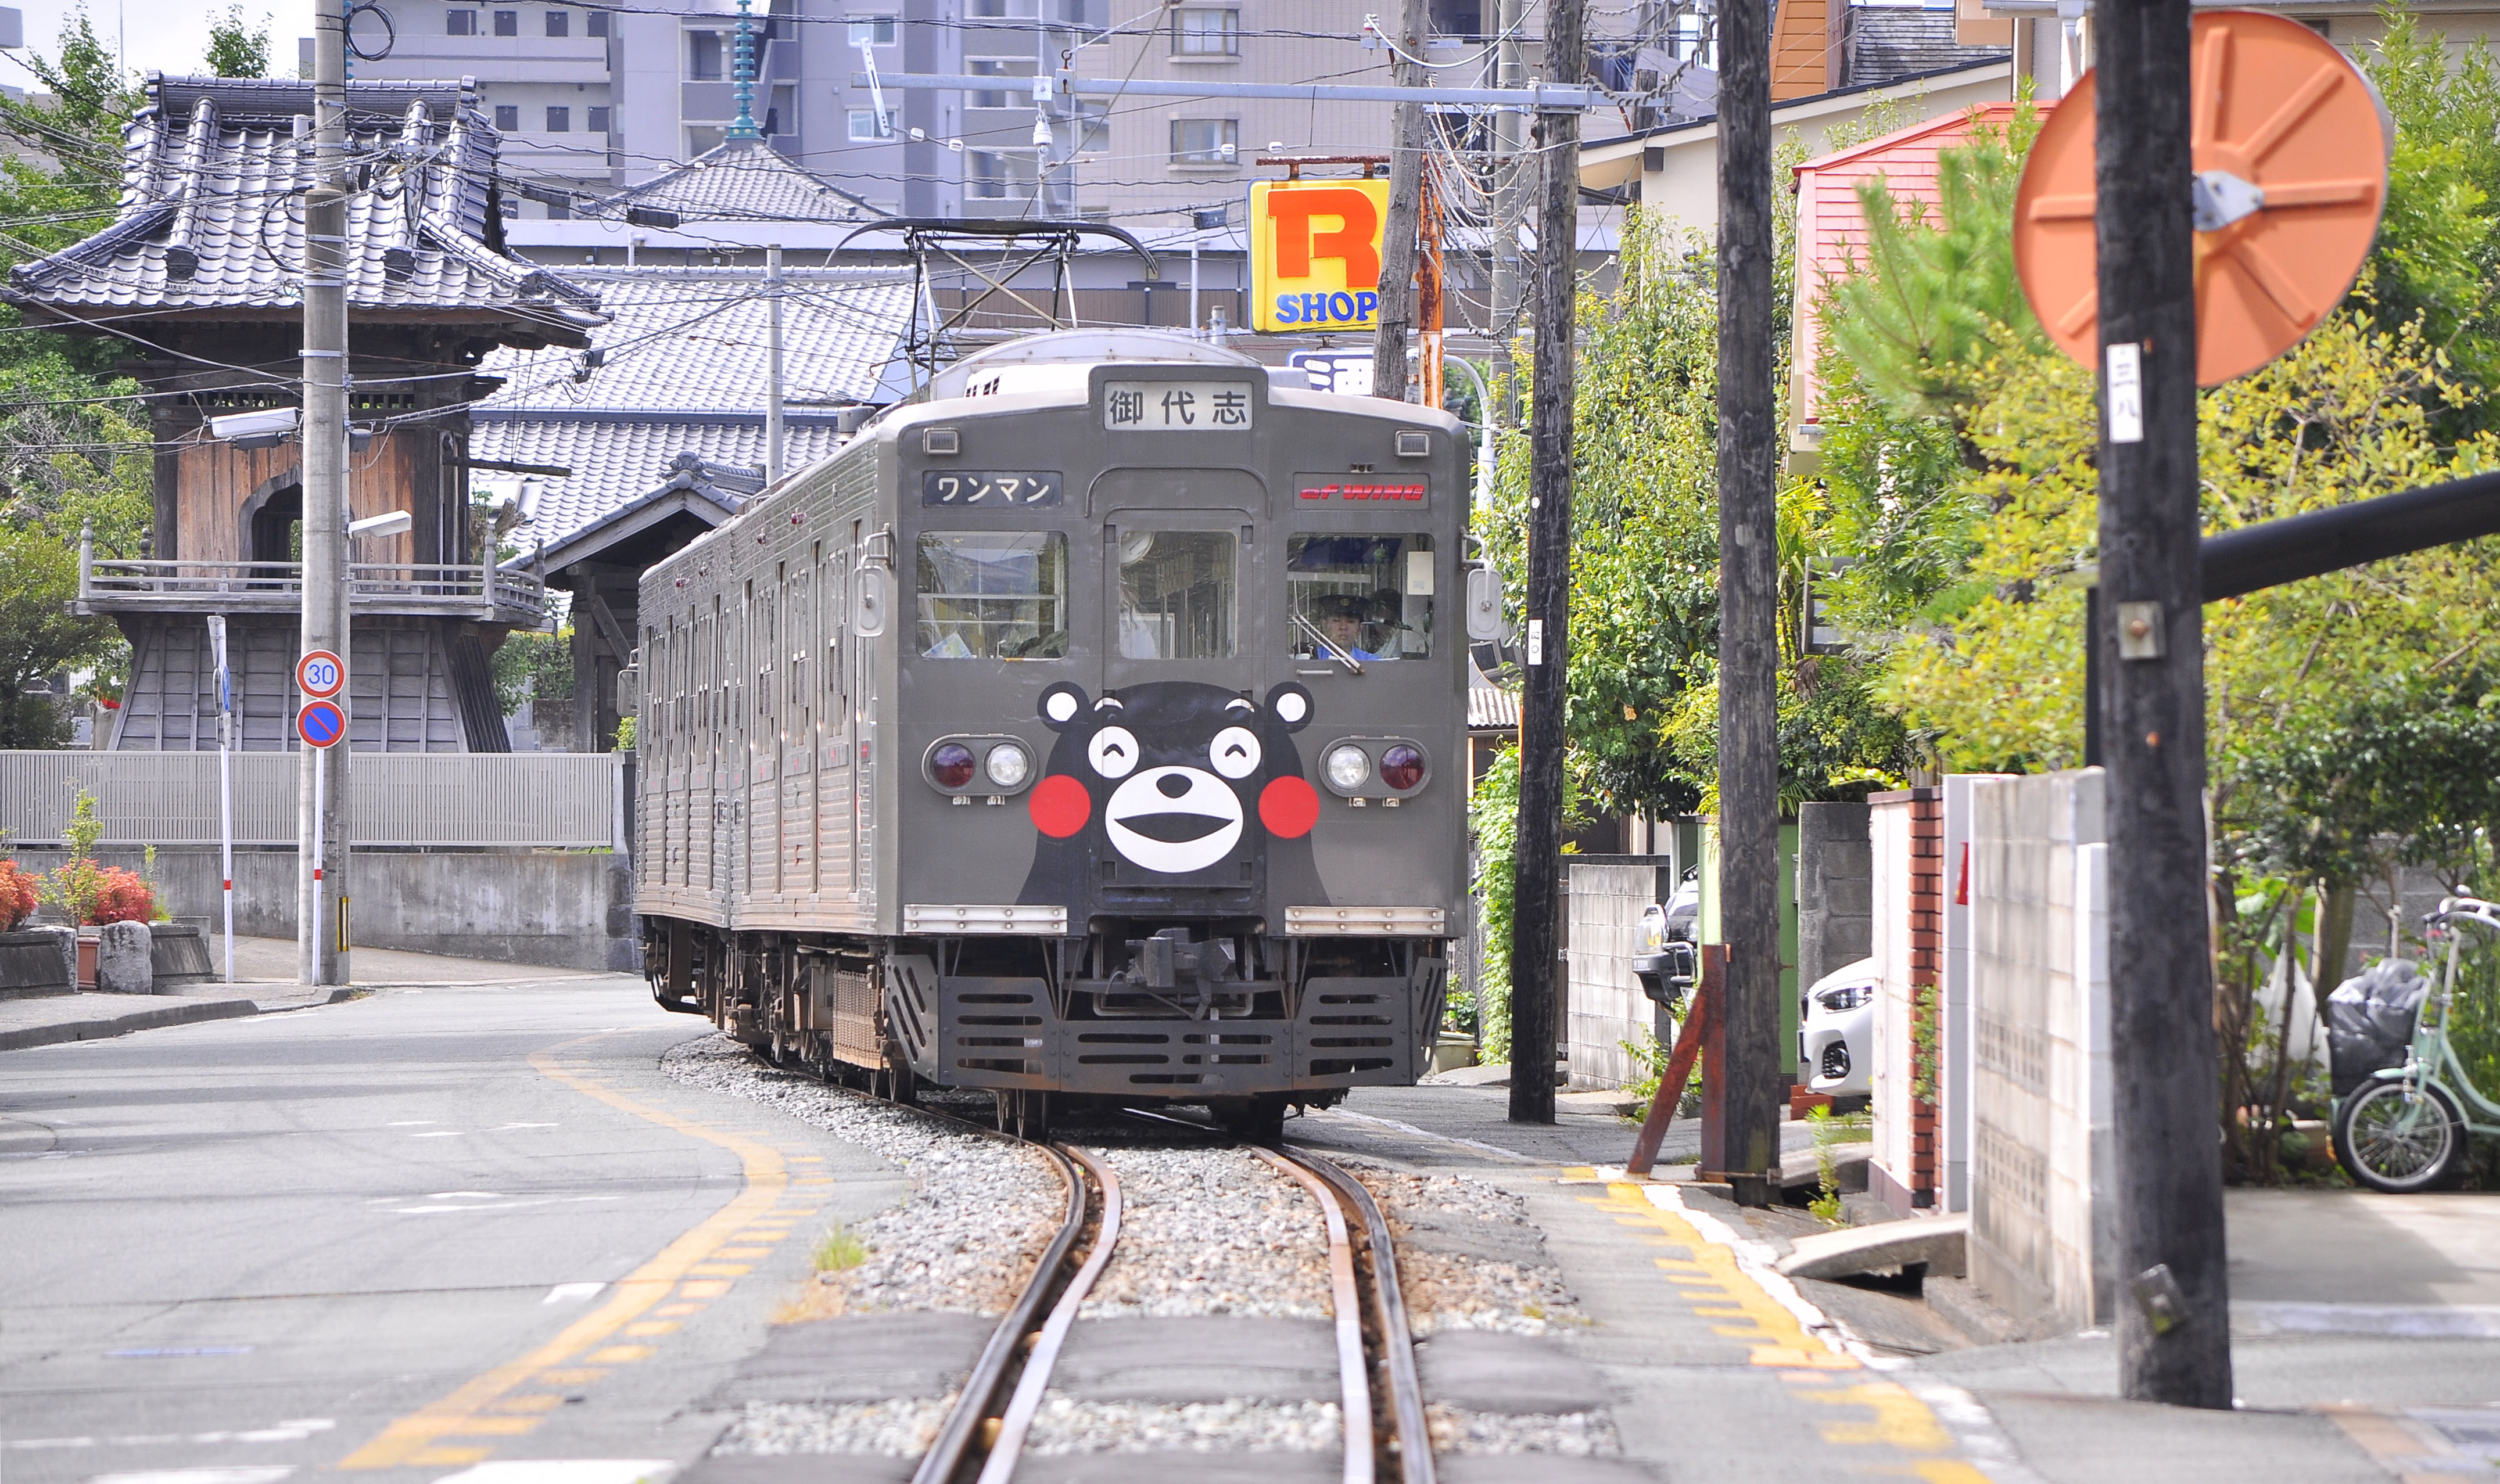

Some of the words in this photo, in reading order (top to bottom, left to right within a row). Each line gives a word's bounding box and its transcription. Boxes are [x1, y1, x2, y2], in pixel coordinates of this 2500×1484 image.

[1268, 189, 1379, 288] R
[1276, 292, 1378, 323] SHOP
[1110, 391, 1246, 425] 御代志
[938, 477, 1049, 502] ワンマン
[309, 664, 334, 684] 30
